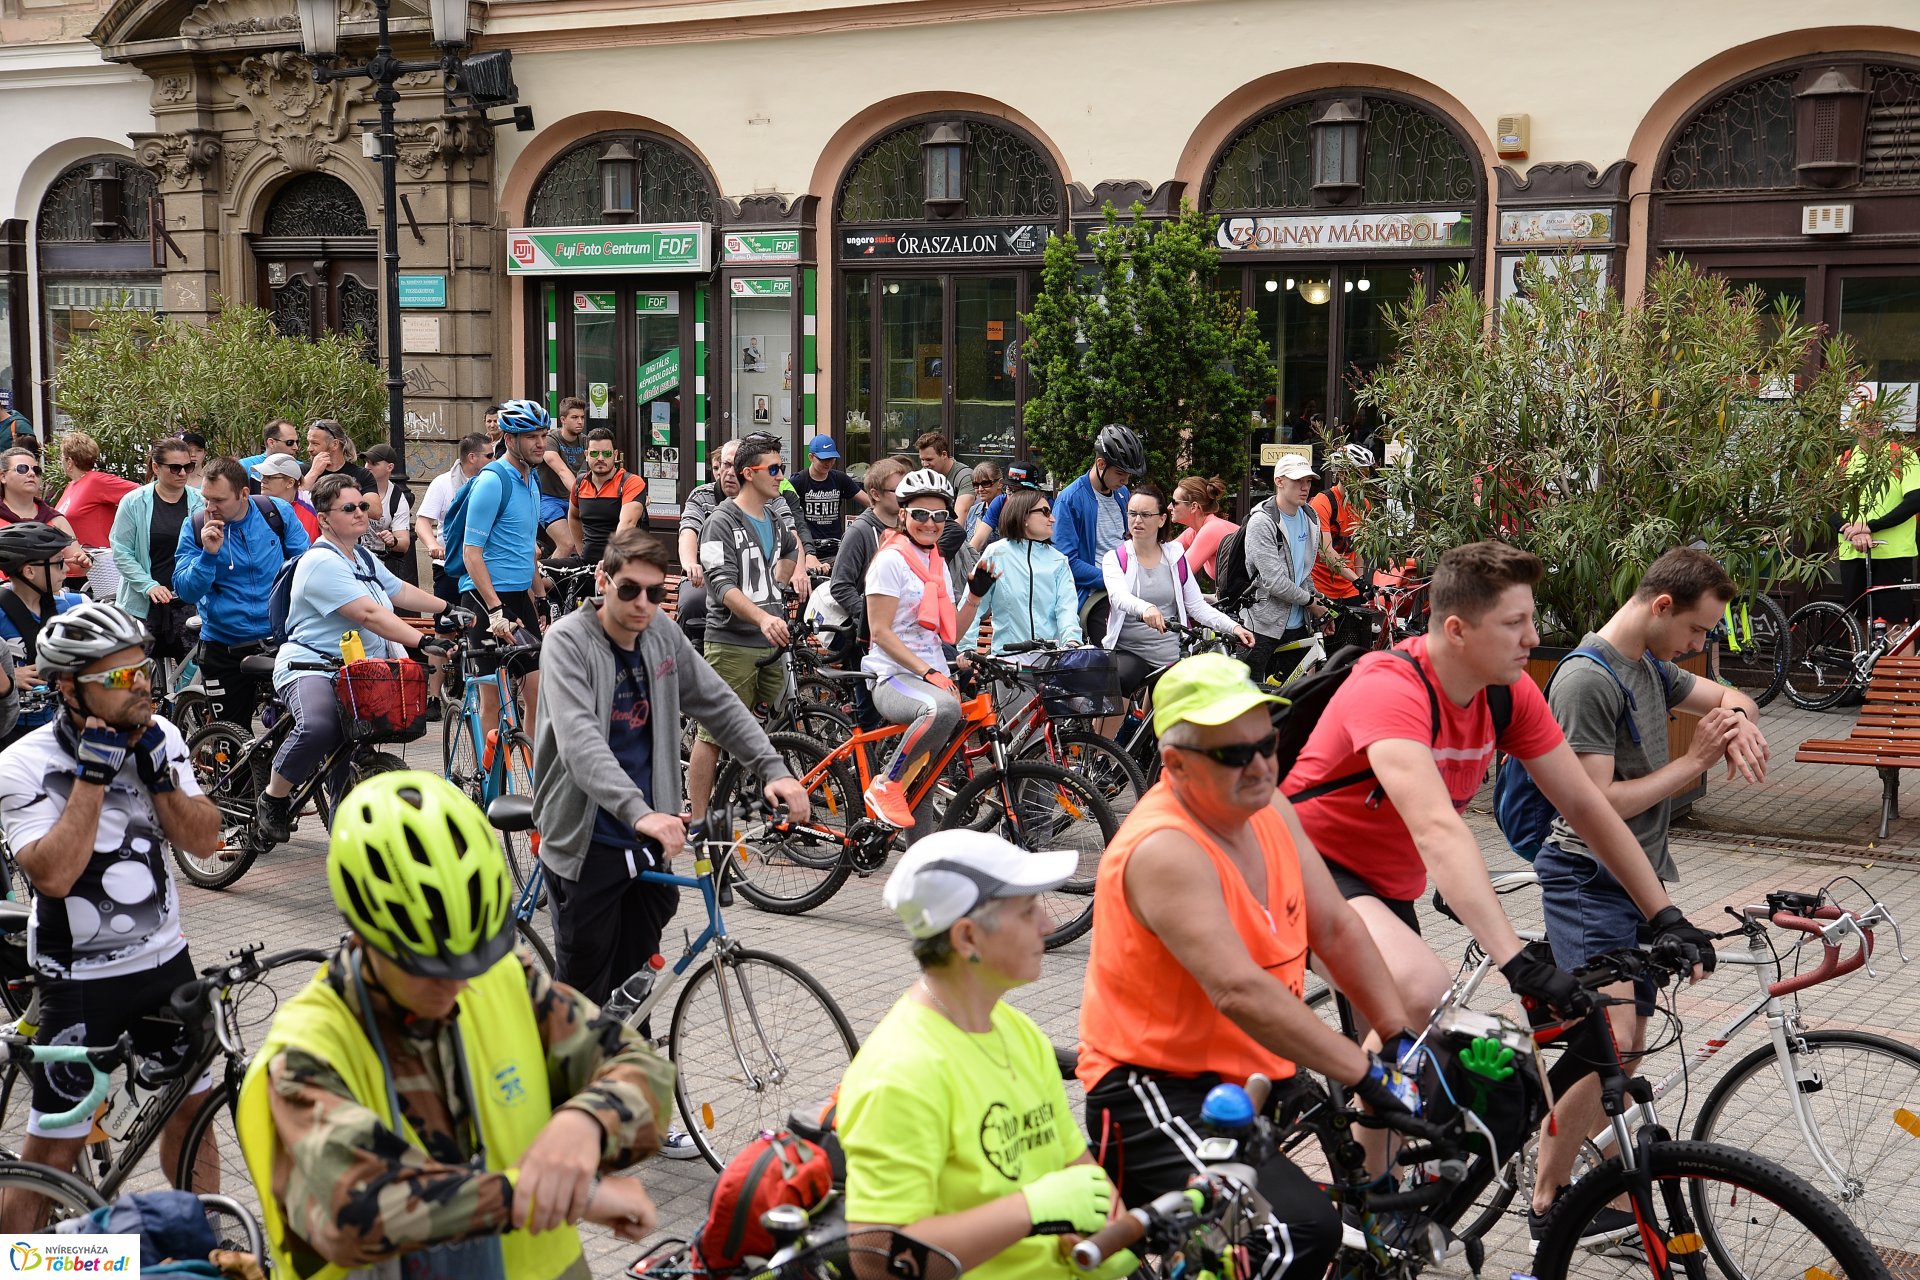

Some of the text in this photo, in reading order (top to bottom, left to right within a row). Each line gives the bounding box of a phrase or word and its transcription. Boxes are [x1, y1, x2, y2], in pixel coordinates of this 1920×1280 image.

[1232, 219, 1457, 245] ZSOLNAY MÁRKABOLT
[603, 241, 650, 256] Centrum
[658, 237, 694, 255] FDF
[775, 240, 795, 251] FDF
[896, 232, 998, 254] ÓRASZALON
[773, 282, 789, 291] FDF
[648, 297, 665, 307] FDF
[645, 356, 670, 375] DIGITÁLIS
[795, 825, 836, 841] MERIDA
